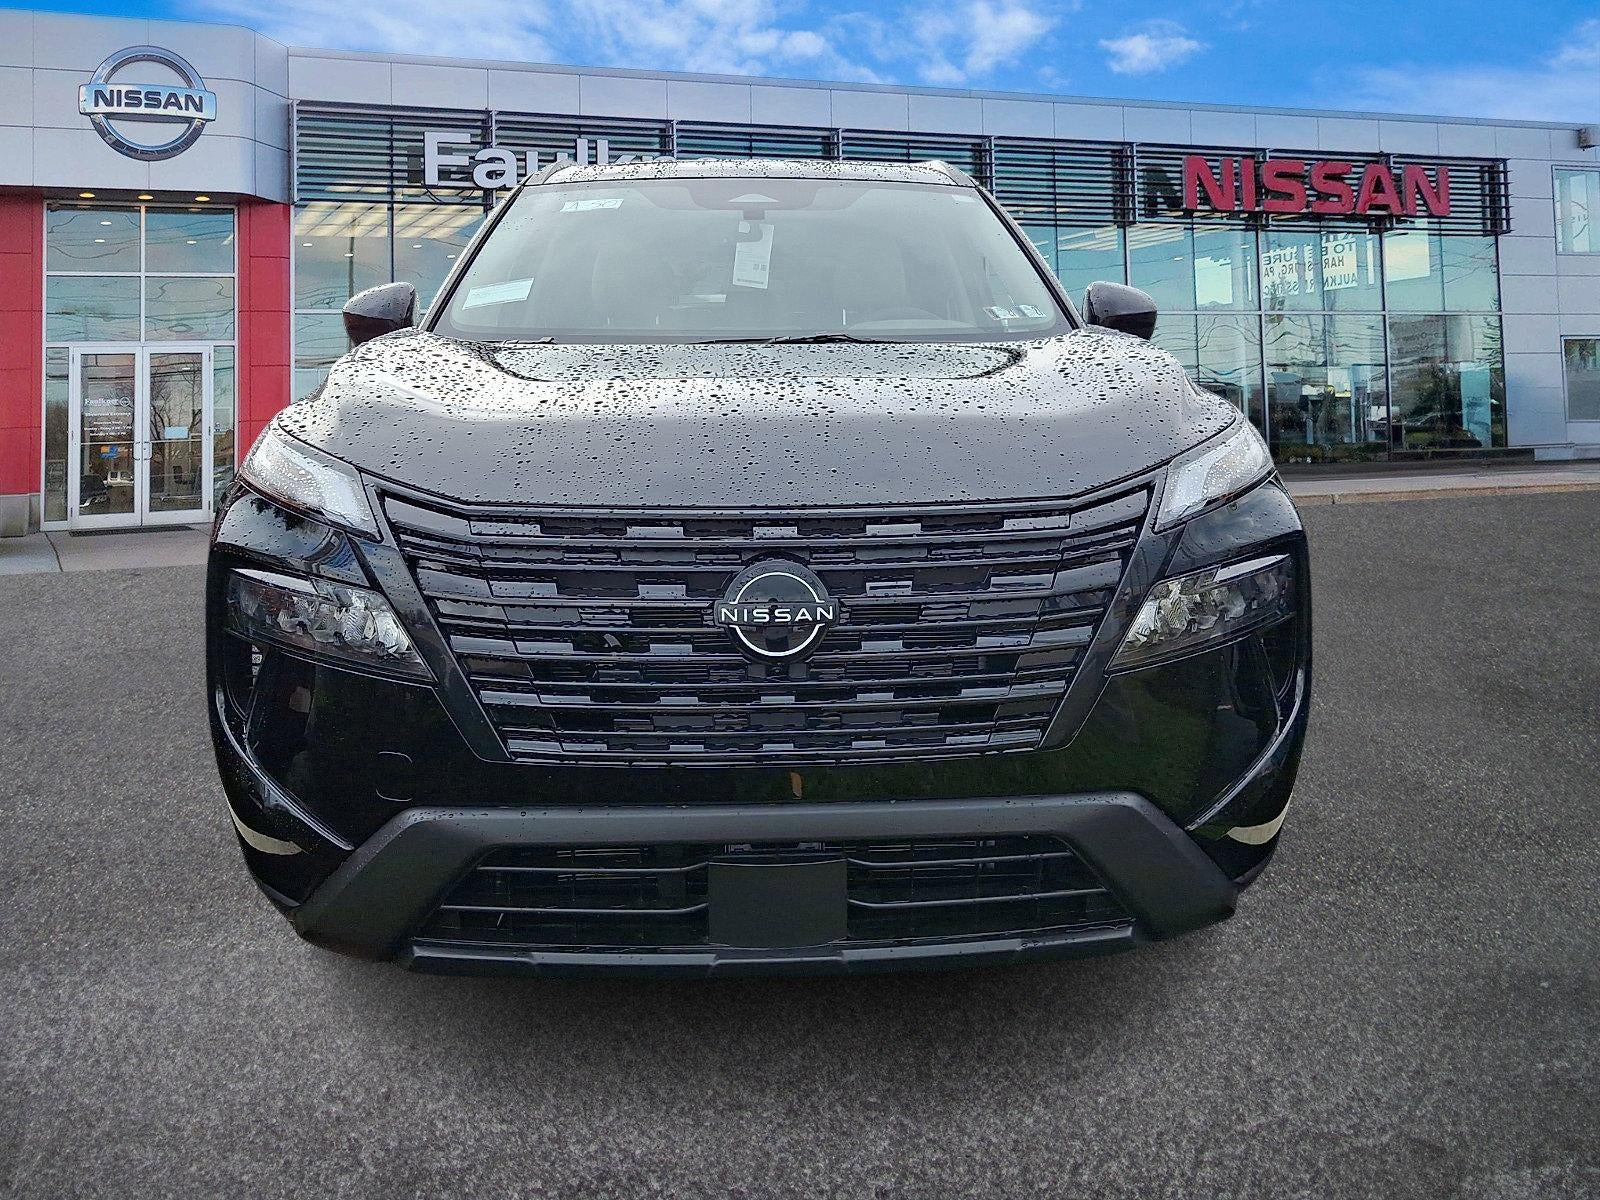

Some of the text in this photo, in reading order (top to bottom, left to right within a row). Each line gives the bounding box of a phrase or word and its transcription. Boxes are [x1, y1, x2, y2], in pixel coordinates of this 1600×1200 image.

[93, 89, 204, 113] NISSAN
[1182, 154, 1450, 217] NISSAN
[721, 606, 833, 622] NISSAN
